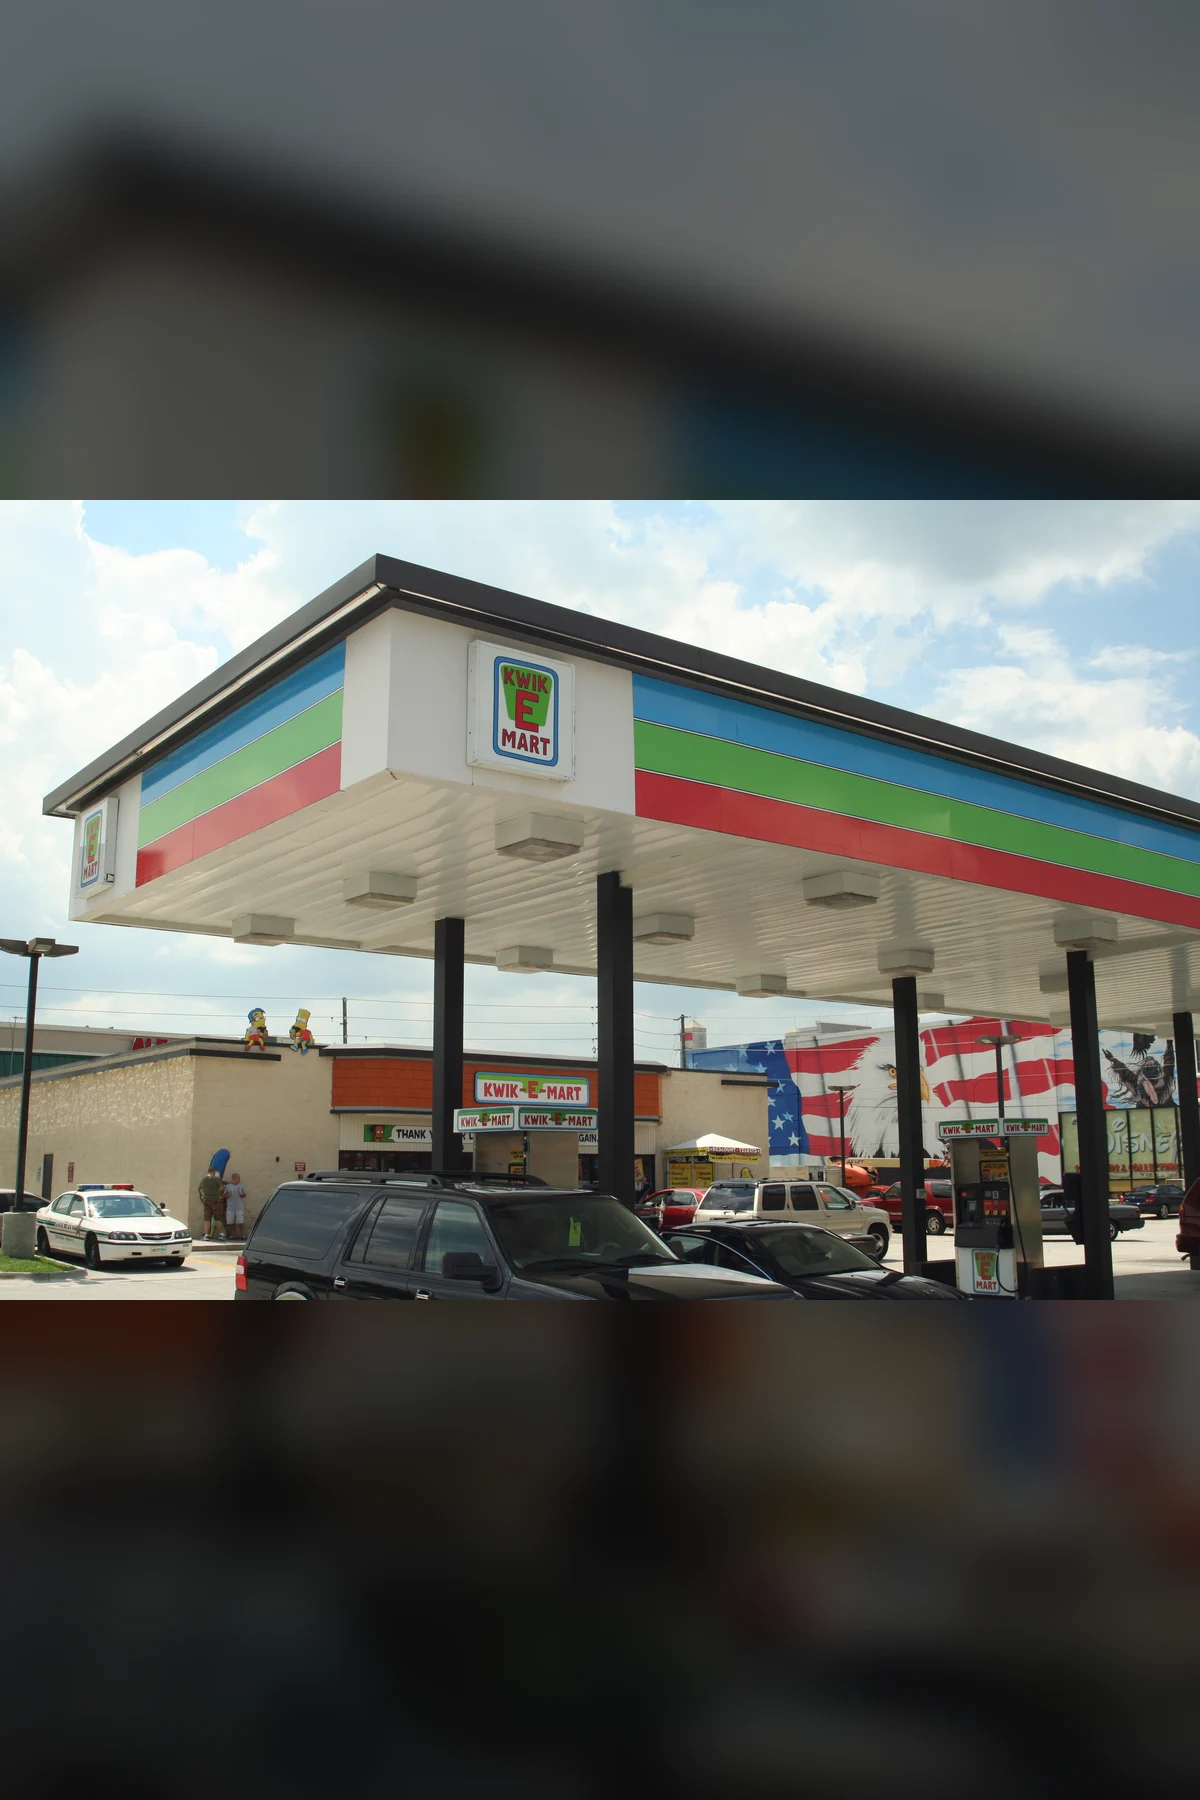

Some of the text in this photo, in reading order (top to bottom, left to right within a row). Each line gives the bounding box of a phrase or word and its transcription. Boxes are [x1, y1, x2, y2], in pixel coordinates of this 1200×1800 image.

[503, 667, 548, 694] KWIK
[515, 689, 539, 733] E
[502, 728, 550, 756] MART
[88, 832, 97, 864] E
[83, 861, 98, 880] MART
[483, 1081, 582, 1101] KWIK-E-MART
[460, 1113, 511, 1128] KWIK-E-MART
[524, 1112, 593, 1127] KWIK-E-MART
[1006, 1122, 1046, 1132] KWIK-E-MART
[396, 1129, 426, 1140] THANK
[943, 1123, 995, 1135] KWIK-E-MART
[578, 1133, 598, 1143] GAIN.
[975, 1252, 996, 1261] KWIK
[981, 1261, 992, 1280] E
[976, 1281, 997, 1290] MART
